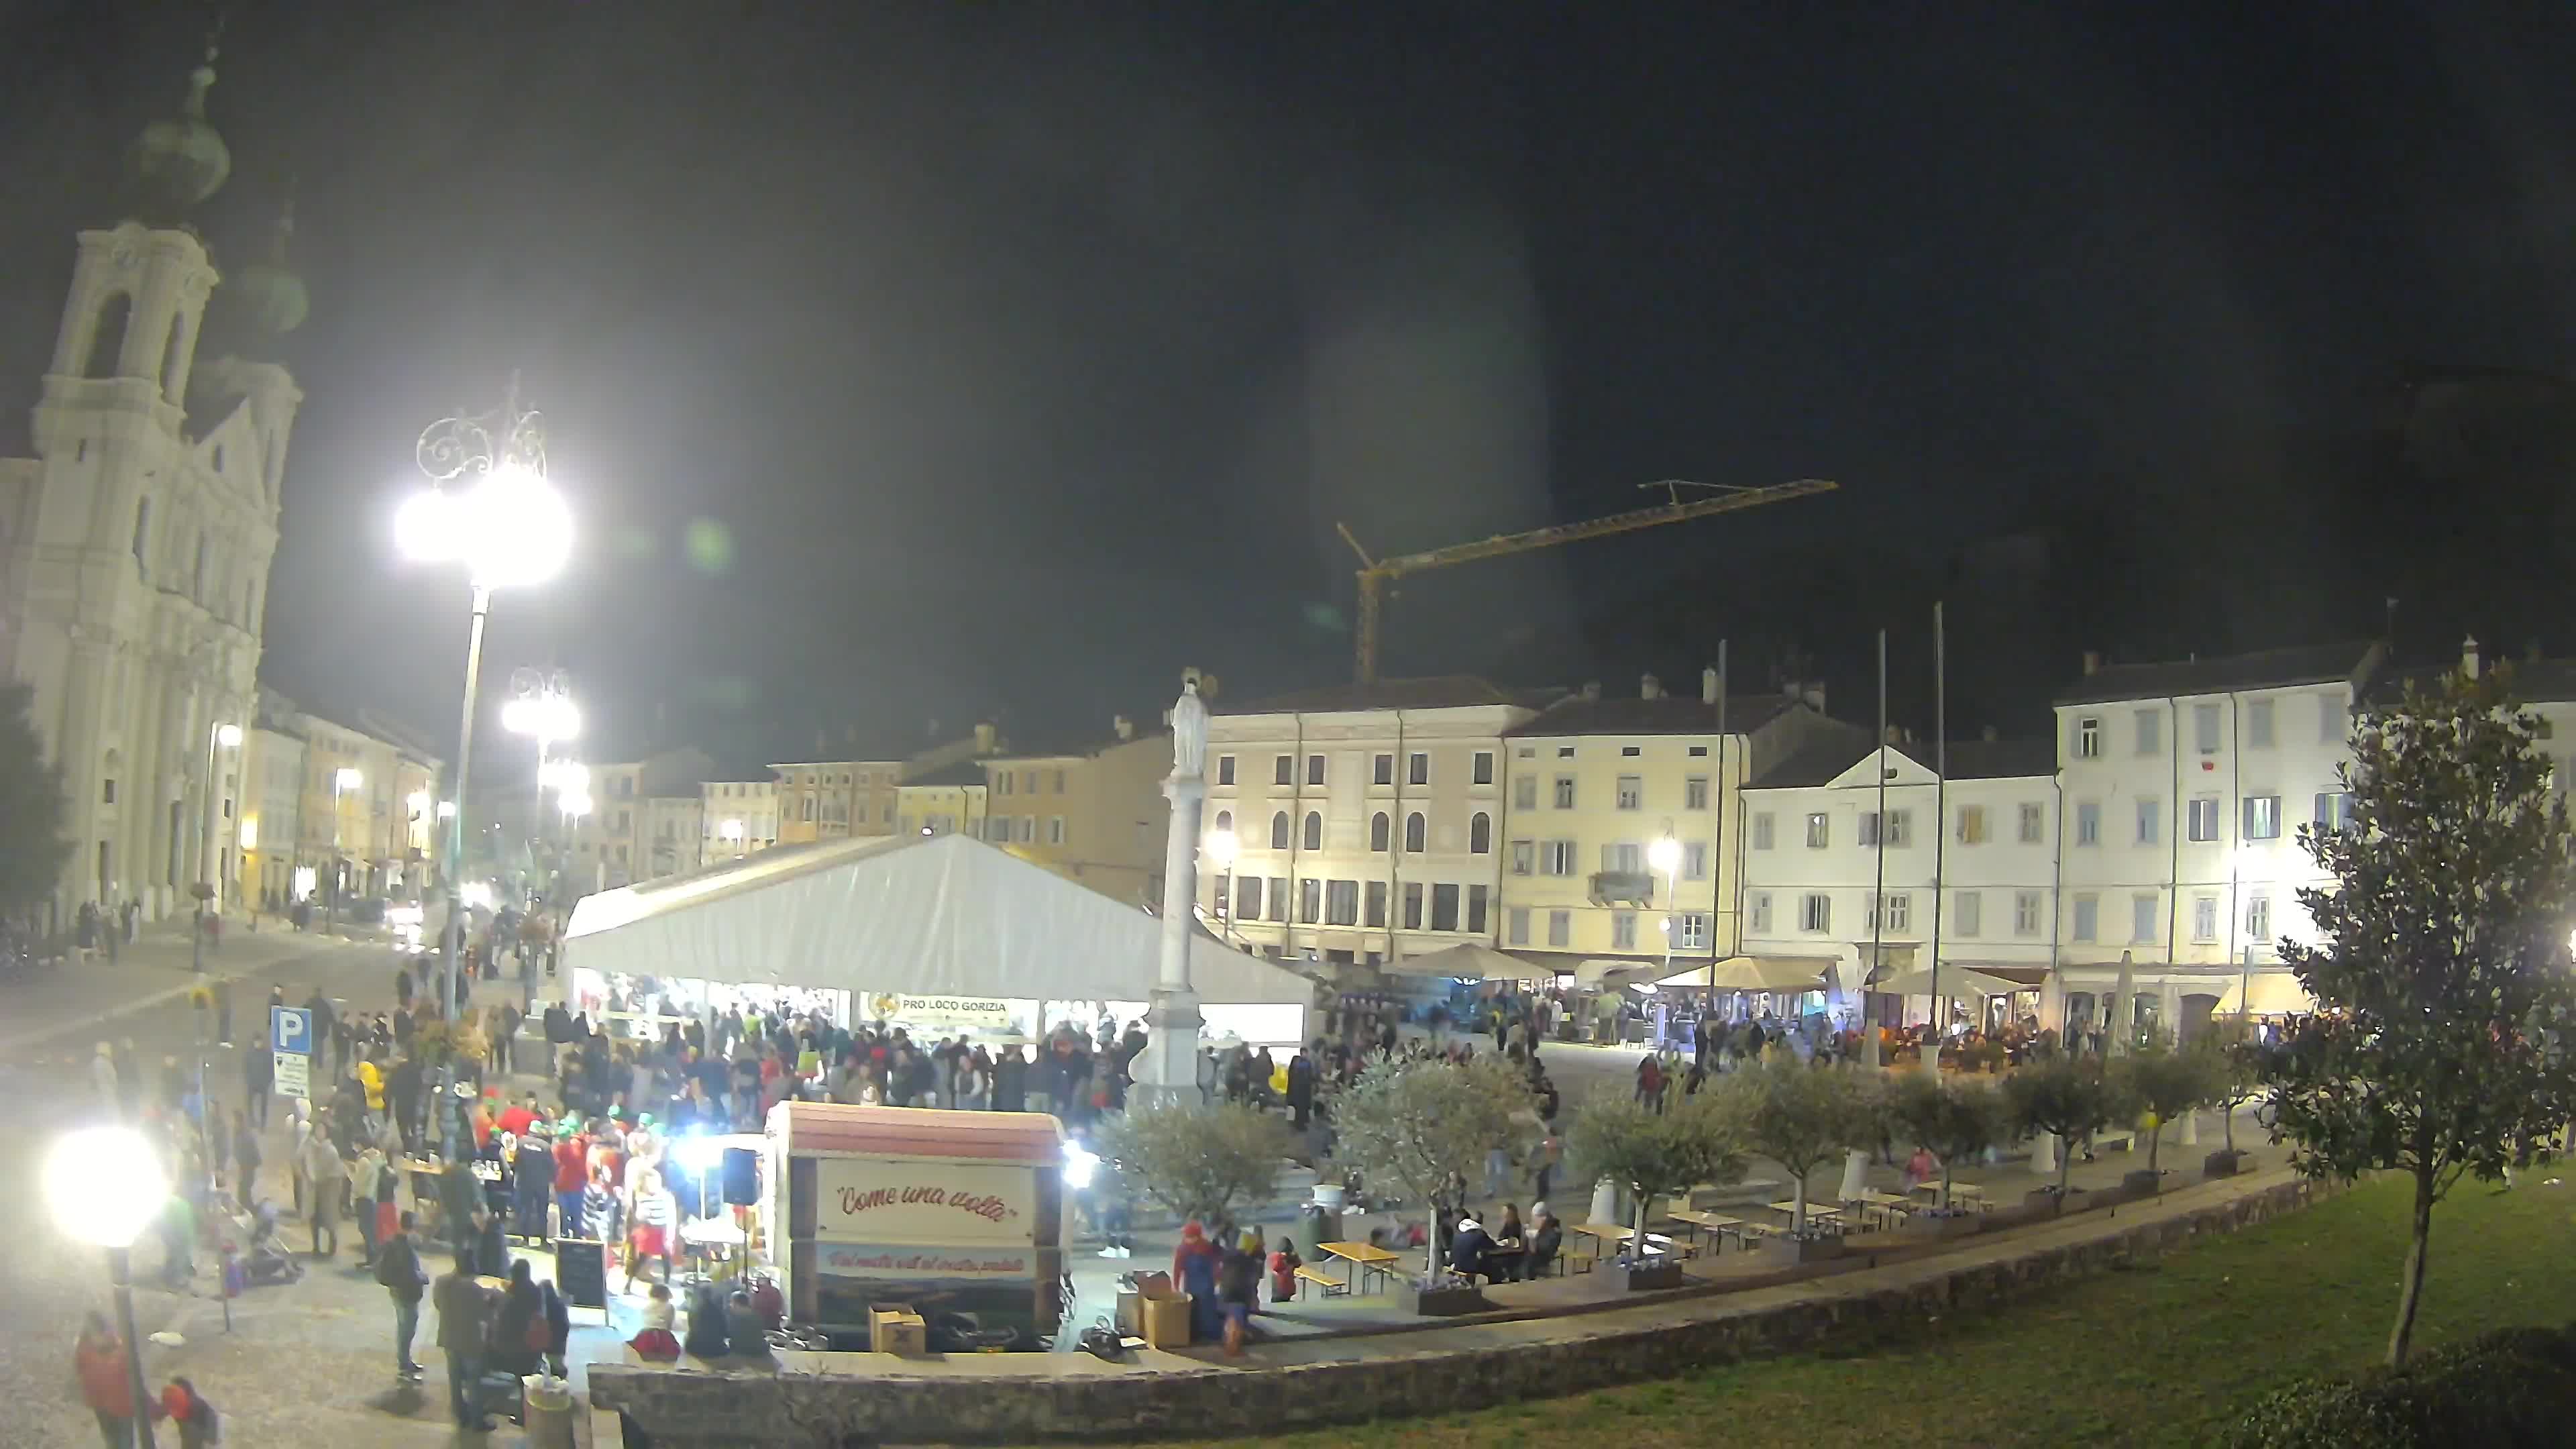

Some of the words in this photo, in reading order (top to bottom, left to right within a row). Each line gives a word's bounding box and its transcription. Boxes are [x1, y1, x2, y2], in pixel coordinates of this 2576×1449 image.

[903, 1000, 926, 1009] PRO
[929, 1000, 959, 1010] LOCO
[961, 1002, 1006, 1012] GORIZIA
[279, 1010, 303, 1046] P
[902, 1186, 945, 1203] una
